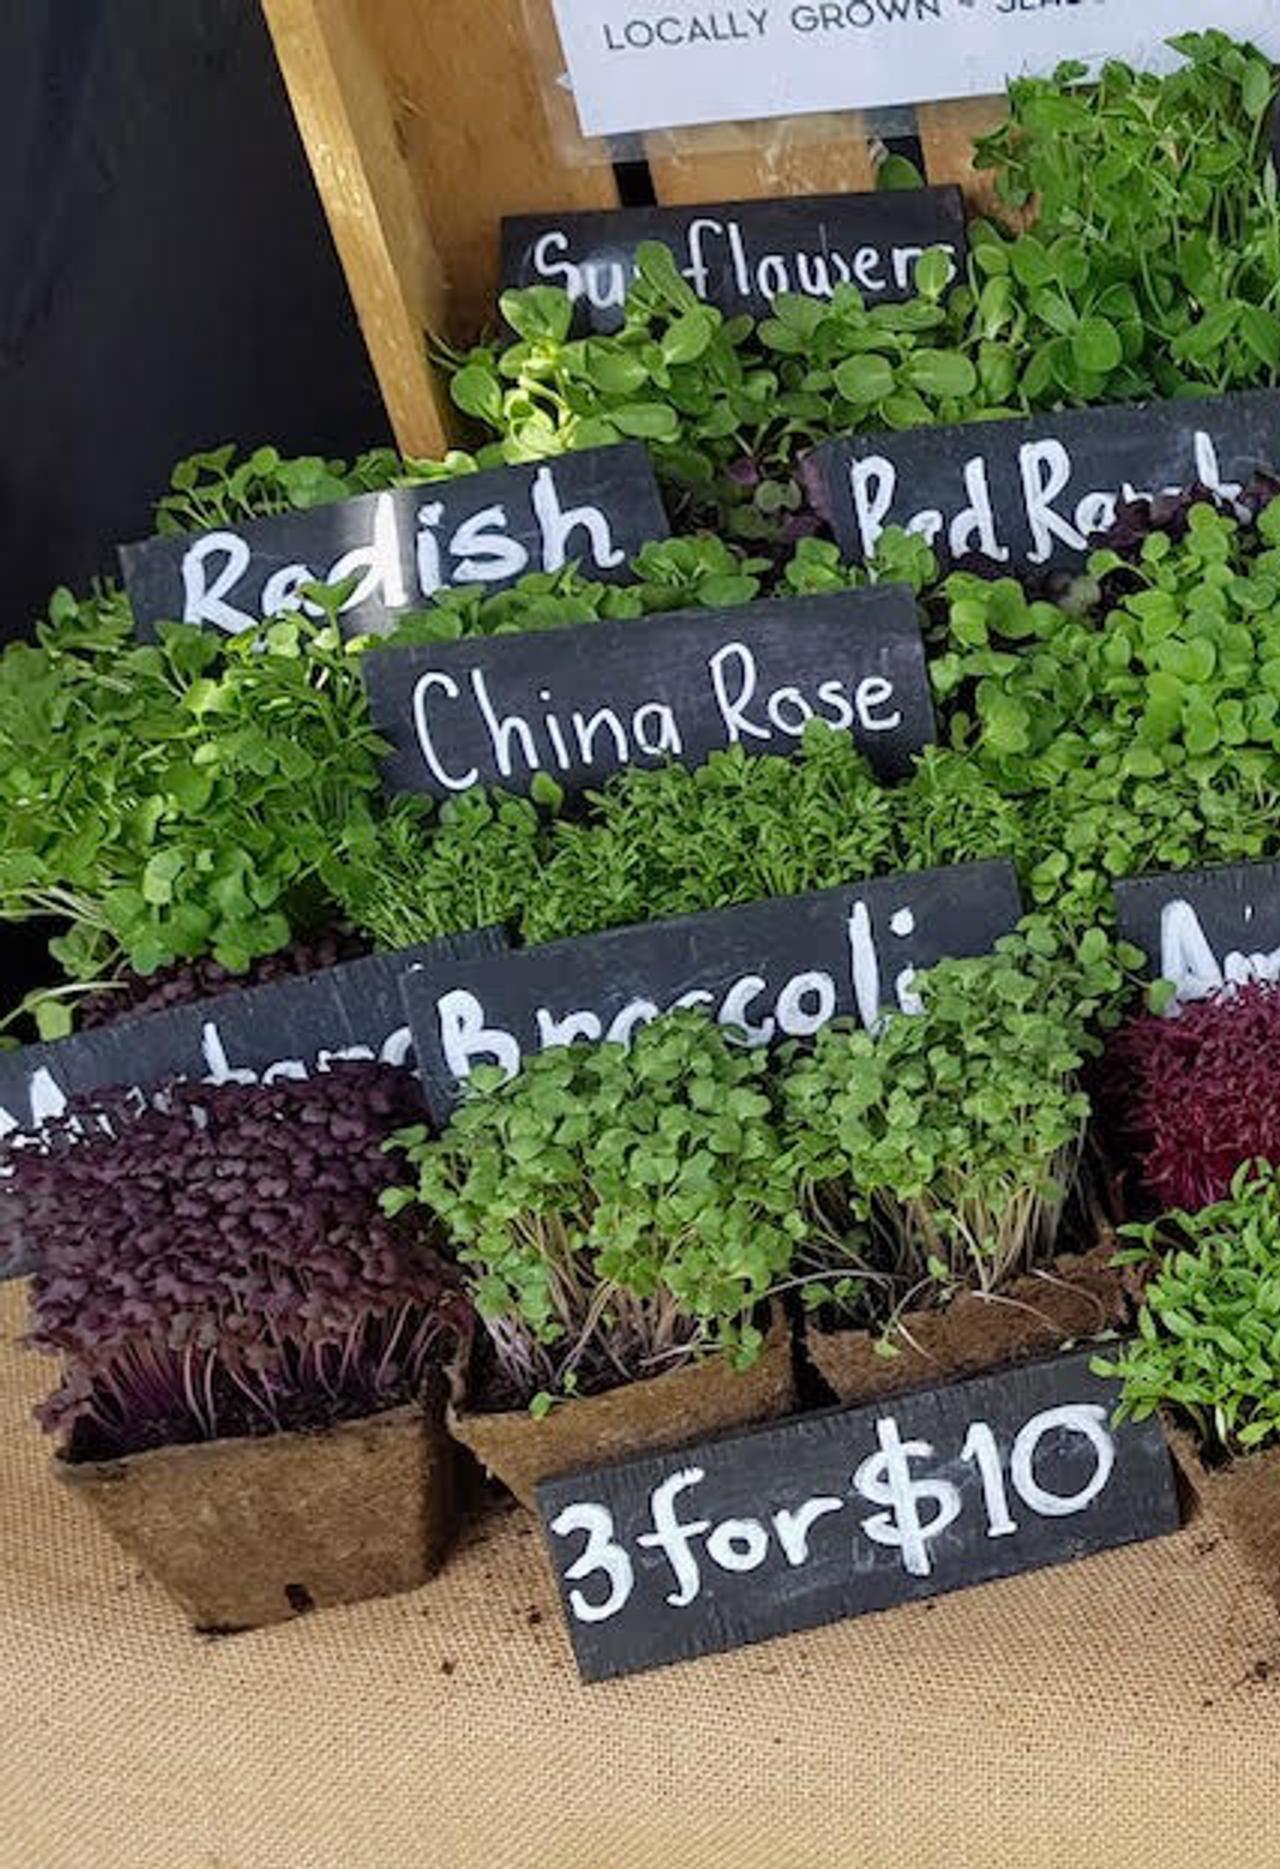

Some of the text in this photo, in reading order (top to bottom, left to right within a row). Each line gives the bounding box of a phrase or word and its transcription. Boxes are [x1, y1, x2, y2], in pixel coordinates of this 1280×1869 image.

[601, 0, 942, 51] LOCALLY GROWN
[412, 641, 902, 790] China Rose
[852, 1402, 1115, 1577] $10
